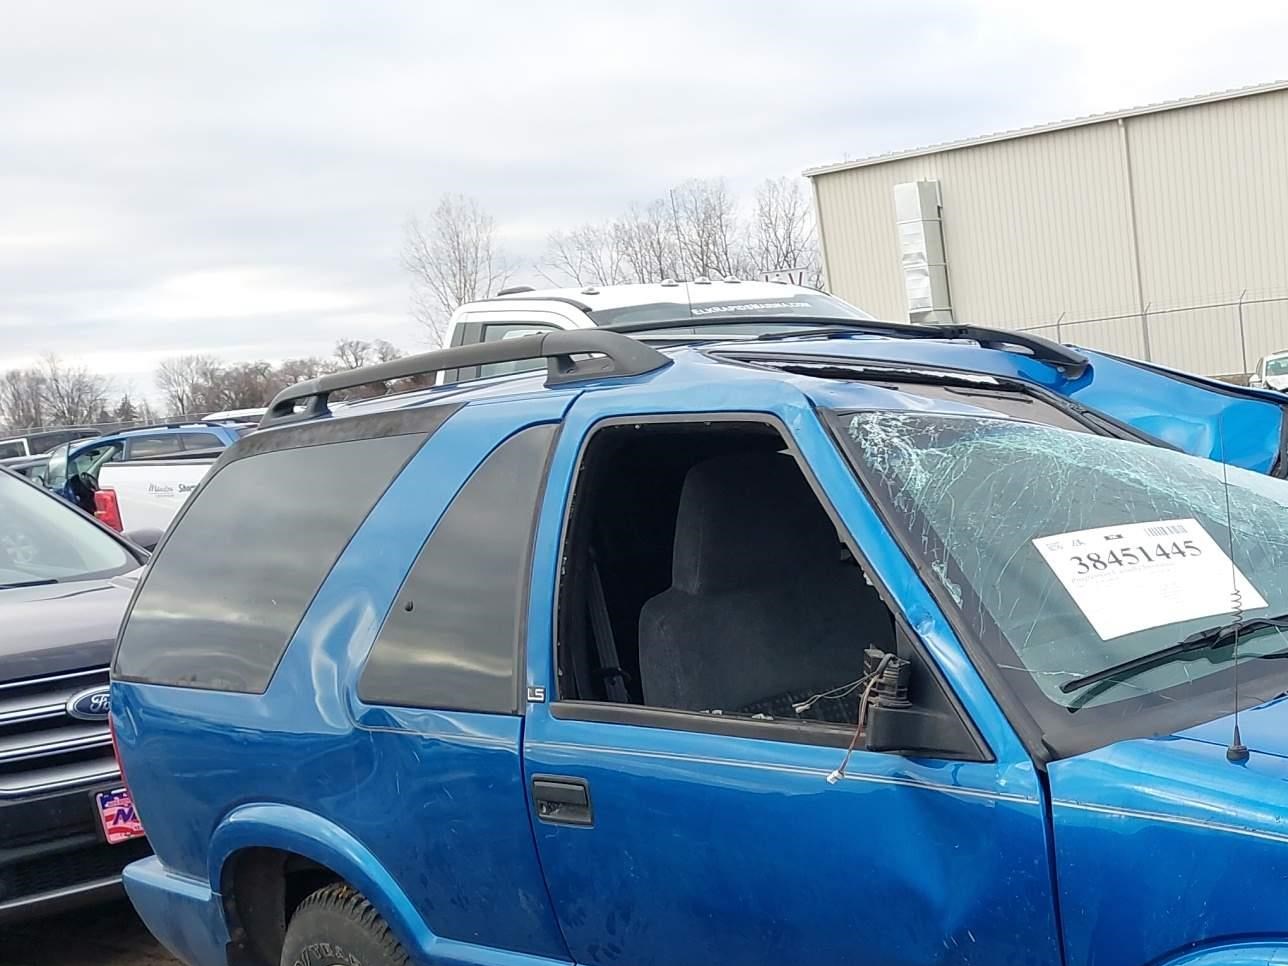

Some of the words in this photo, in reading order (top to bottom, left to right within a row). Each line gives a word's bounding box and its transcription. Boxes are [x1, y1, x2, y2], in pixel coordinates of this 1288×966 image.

[1069, 540, 1203, 575] 38451445
[90, 693, 110, 712] Fo
[527, 687, 545, 701] LS
